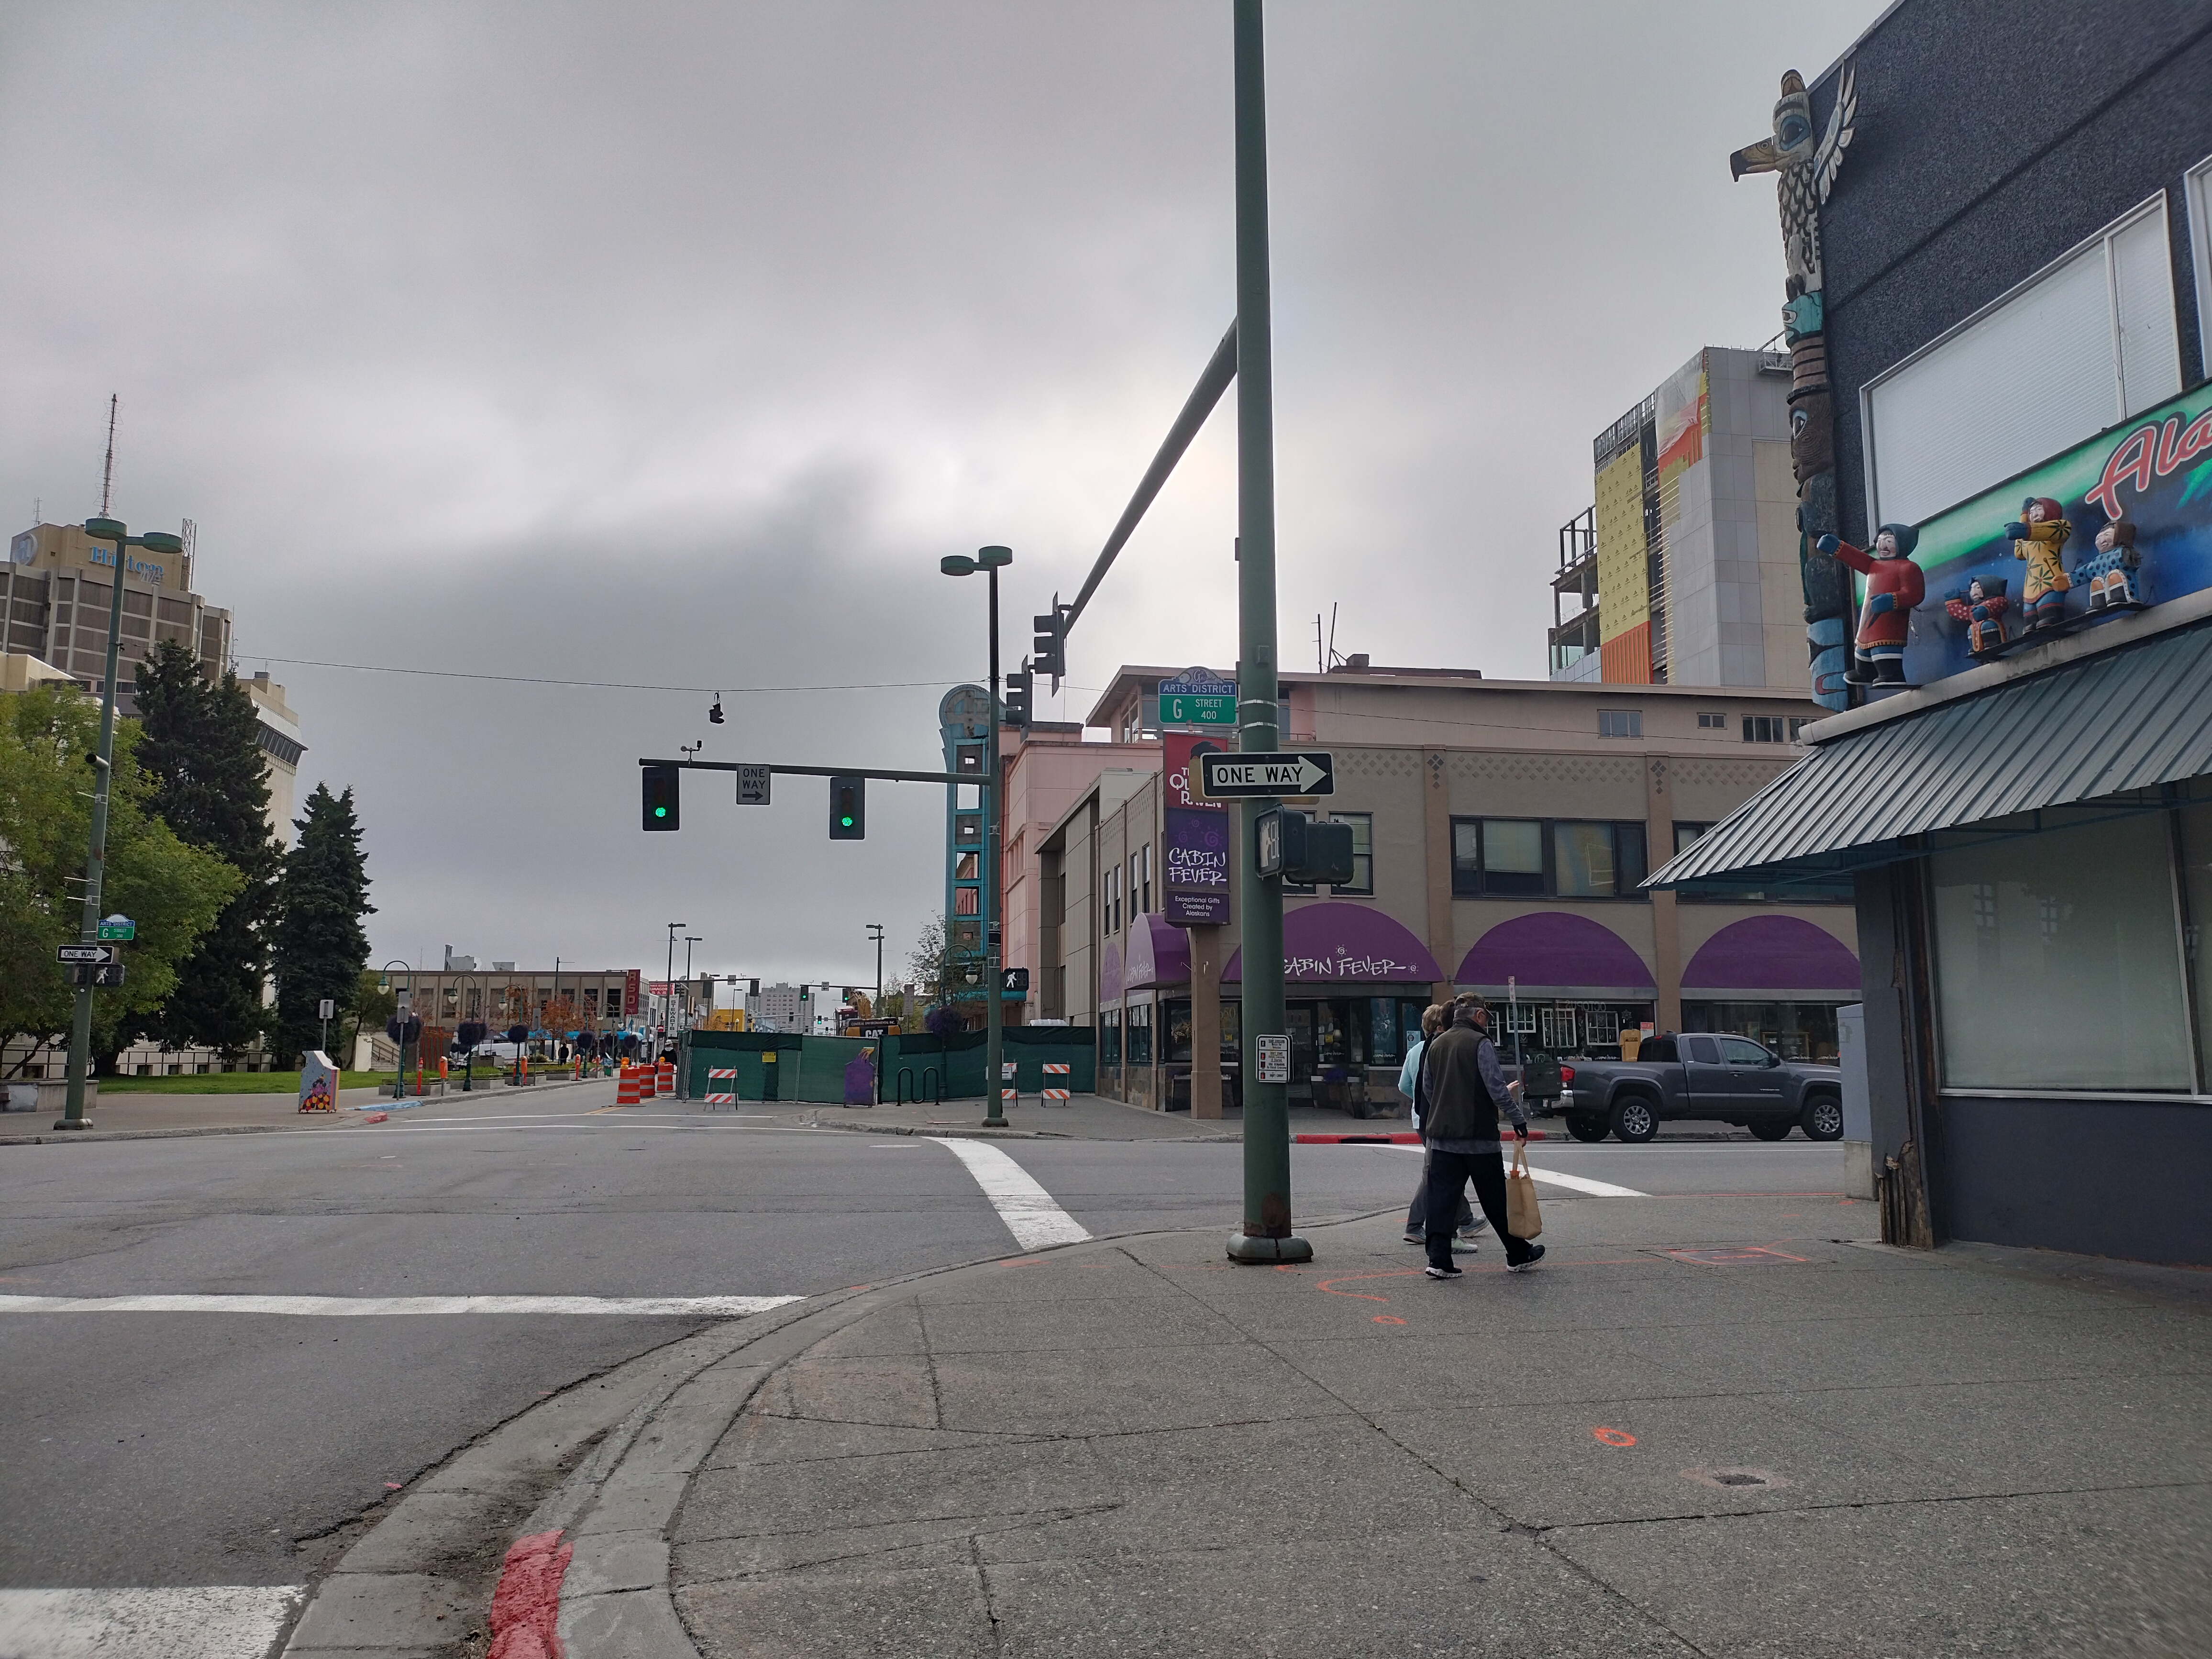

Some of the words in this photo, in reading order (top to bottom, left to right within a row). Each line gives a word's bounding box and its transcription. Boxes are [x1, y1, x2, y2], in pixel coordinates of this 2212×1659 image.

[89, 546, 164, 578] Hiton
[1163, 684, 1187, 693] ARTS
[1192, 685, 1232, 693] DISTRICT
[1173, 699, 1182, 719] G
[1195, 699, 1222, 708] STREET
[1201, 711, 1217, 719] 400
[743, 768, 765, 777] ONE
[1217, 767, 1255, 783] ONE
[1265, 766, 1304, 783] WAY
[742, 780, 765, 789] WAY
[1169, 848, 1226, 868] CABIN
[1169, 867, 1227, 885] FEVER
[102, 928, 109, 938] G
[1284, 957, 1332, 976] ABIN
[1337, 955, 1406, 976] FEVER
[865, 1029, 883, 1038] CAT
